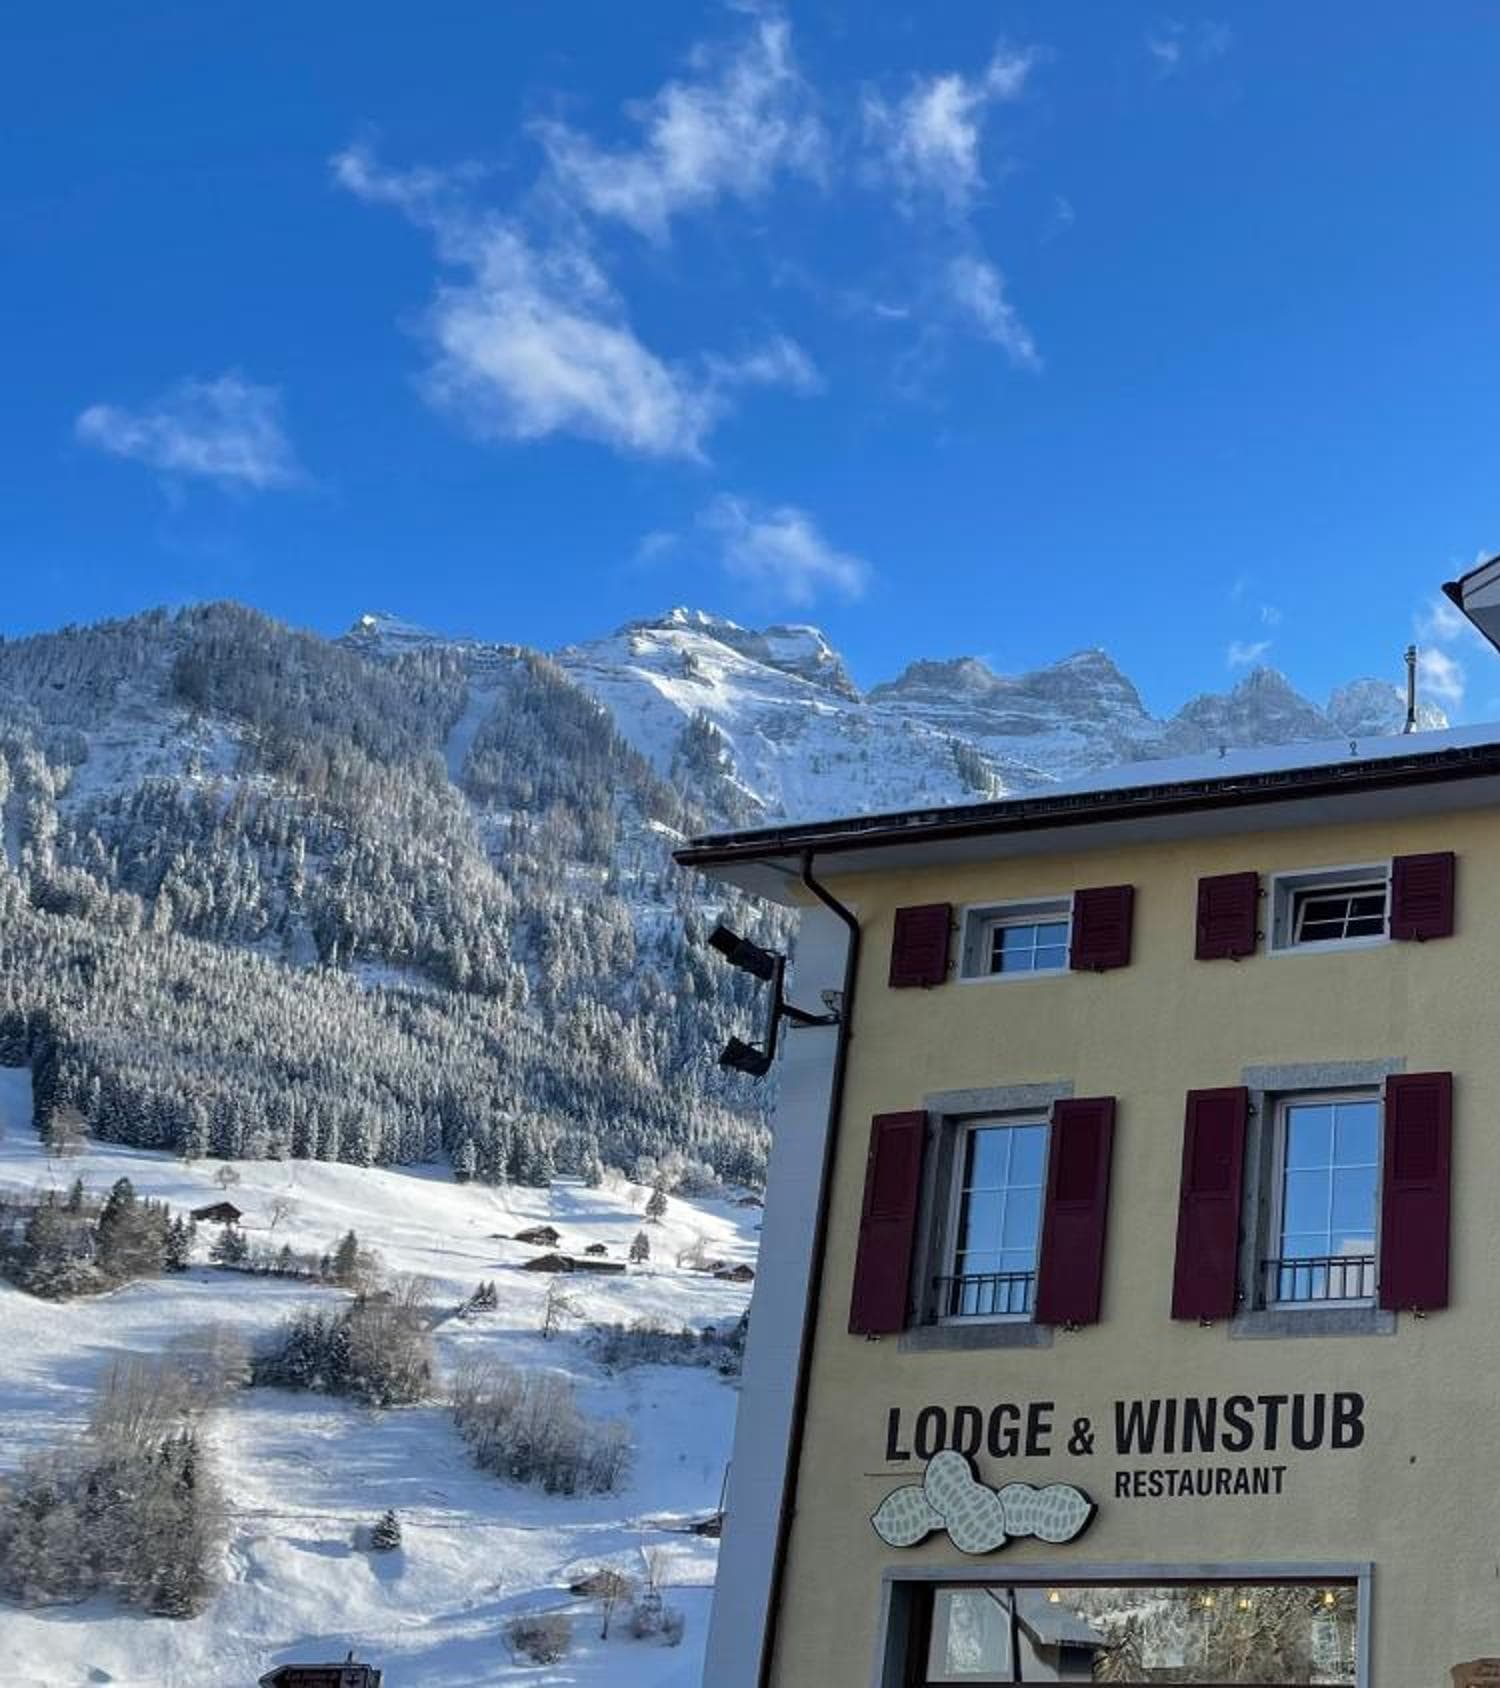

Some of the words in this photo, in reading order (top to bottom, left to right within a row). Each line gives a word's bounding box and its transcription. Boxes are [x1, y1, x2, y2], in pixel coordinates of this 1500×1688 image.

[886, 1401, 1055, 1461] LODGE
[1067, 1416, 1095, 1456] &
[1114, 1392, 1366, 1454] WINSTUB
[1114, 1466, 1287, 1498] RESTAURANT
